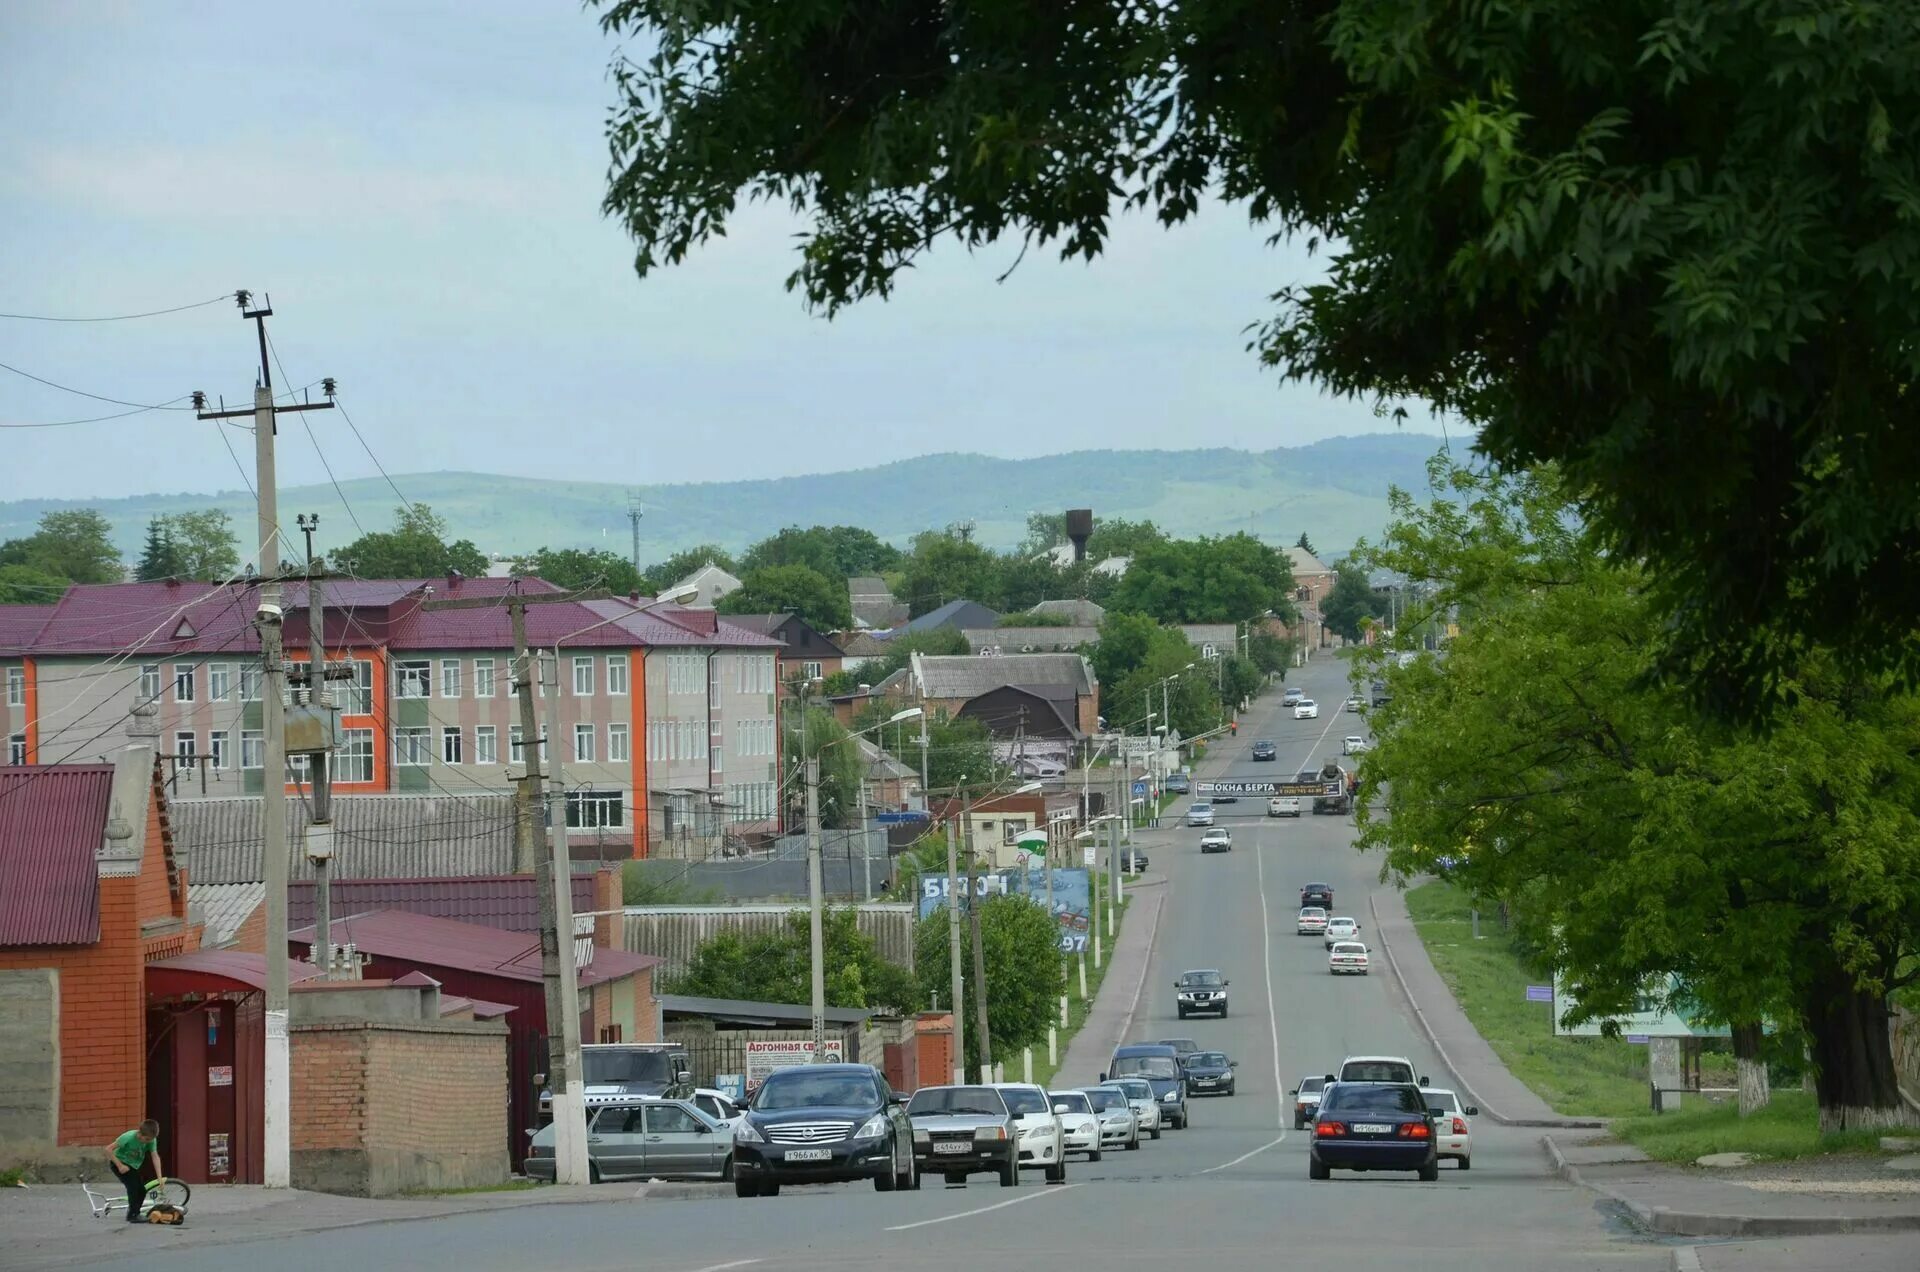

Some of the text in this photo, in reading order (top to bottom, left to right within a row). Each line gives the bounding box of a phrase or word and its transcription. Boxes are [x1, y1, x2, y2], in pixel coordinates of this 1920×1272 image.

[1215, 783, 1242, 792] ОКНА
[1245, 783, 1275, 792] БЕРТА
[748, 1042, 840, 1053] Аргонная свка
